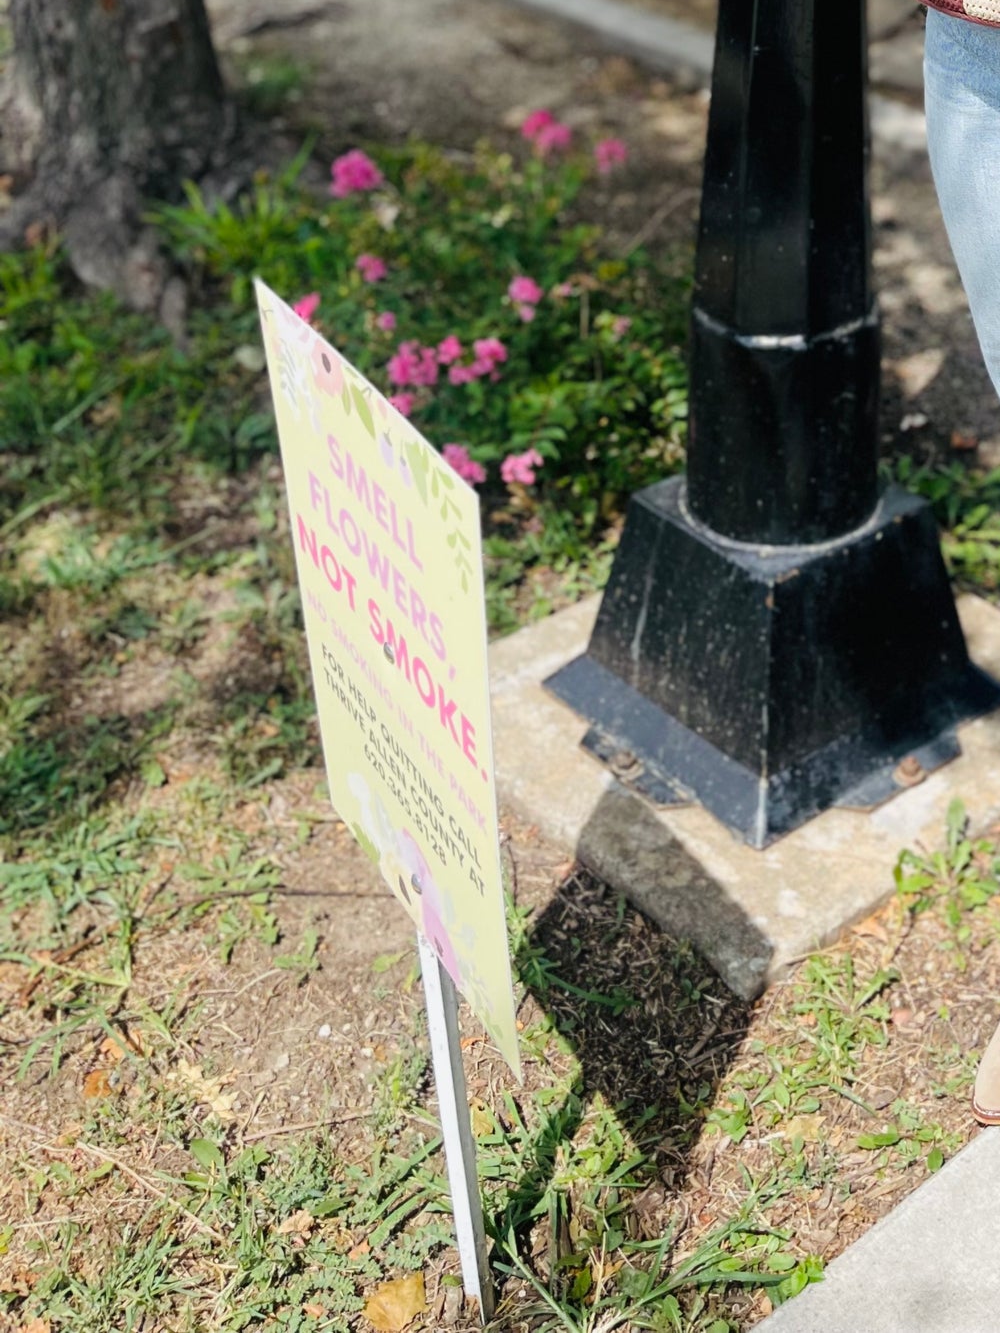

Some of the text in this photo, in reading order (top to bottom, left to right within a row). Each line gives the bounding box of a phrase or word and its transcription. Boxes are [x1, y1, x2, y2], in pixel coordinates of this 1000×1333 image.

[308, 469, 457, 682] FLOWERS,
[327, 433, 424, 573] SMELL
[297, 512, 488, 783] NOT SMOKE.
[306, 587, 487, 837] NO SMOKING IN THE PARK
[322, 642, 482, 870] FOR HELP QUITTING CALL
[323, 667, 486, 898] THRIVE ALLEN COUNTY AT
